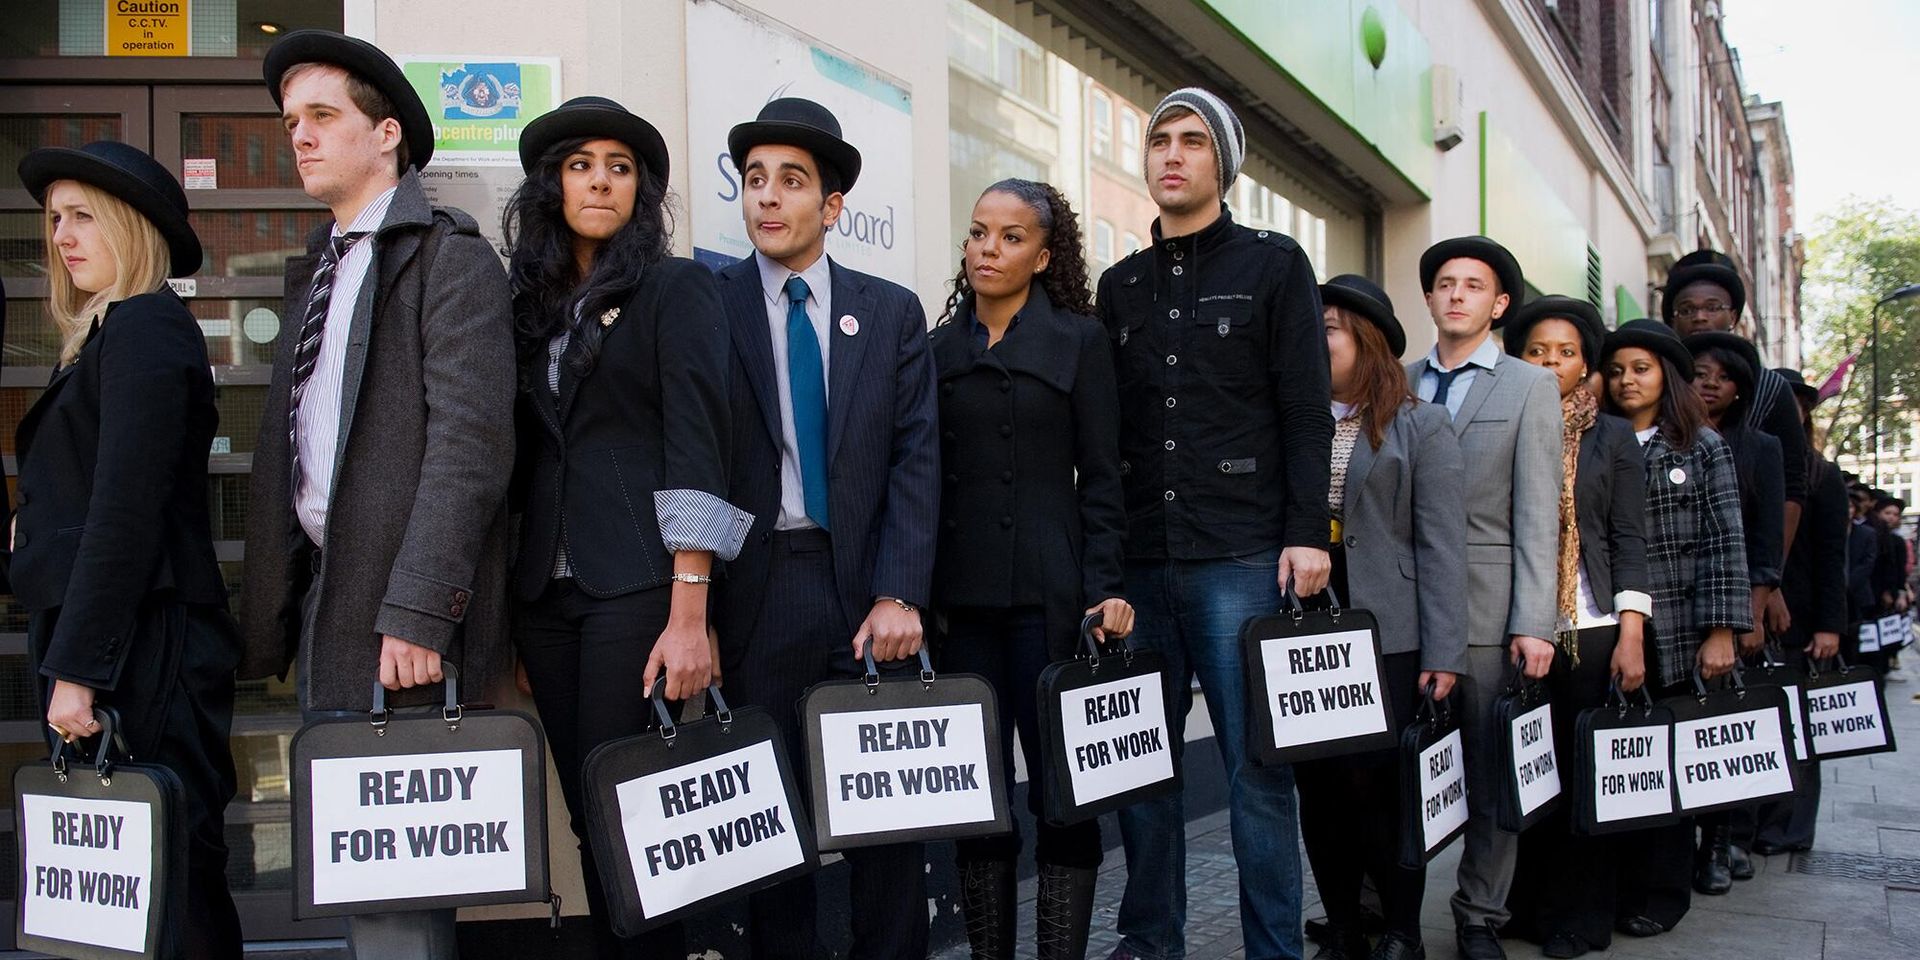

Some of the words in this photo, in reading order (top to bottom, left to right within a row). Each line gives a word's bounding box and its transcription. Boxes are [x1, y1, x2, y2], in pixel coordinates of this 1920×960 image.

[117, 0, 179, 13] Caution
[122, 41, 174, 51] operation
[143, 29, 153, 38] in
[434, 124, 519, 144] bcentreplu
[417, 170, 452, 180] Opening
[455, 169, 479, 178] times
[171, 282, 187, 293] PULL
[1288, 643, 1351, 675] READY
[1085, 687, 1141, 725] READY
[1278, 690, 1316, 717] FOR
[1319, 682, 1375, 710] WORK
[1809, 691, 1856, 713] READY
[858, 718, 950, 753] READY
[1521, 717, 1542, 748] READY
[1695, 720, 1756, 749] READY
[1810, 722, 1828, 737] OR
[1832, 714, 1876, 734] WORK
[1075, 740, 1112, 772] FOR
[1113, 727, 1163, 762] WORK
[1429, 744, 1454, 780] READY
[1611, 736, 1653, 760] READY
[840, 771, 893, 801] FOR
[898, 764, 979, 795] WORK
[1519, 762, 1534, 787] FOR
[1533, 750, 1554, 778] WORK
[1602, 774, 1625, 795] FOR
[1628, 770, 1665, 792] WORK
[1685, 761, 1721, 784] FOR
[1724, 751, 1779, 776] WORK
[359, 766, 478, 806] READY
[659, 761, 751, 818] READY
[1426, 793, 1441, 821] FOR
[1442, 777, 1464, 810] WORK
[52, 811, 124, 850] READY
[330, 829, 396, 862] FOR
[405, 820, 510, 858] WORK
[644, 833, 705, 877] FOR
[708, 805, 786, 855] WORK
[36, 866, 72, 900] FOR
[78, 871, 140, 909] WORK
